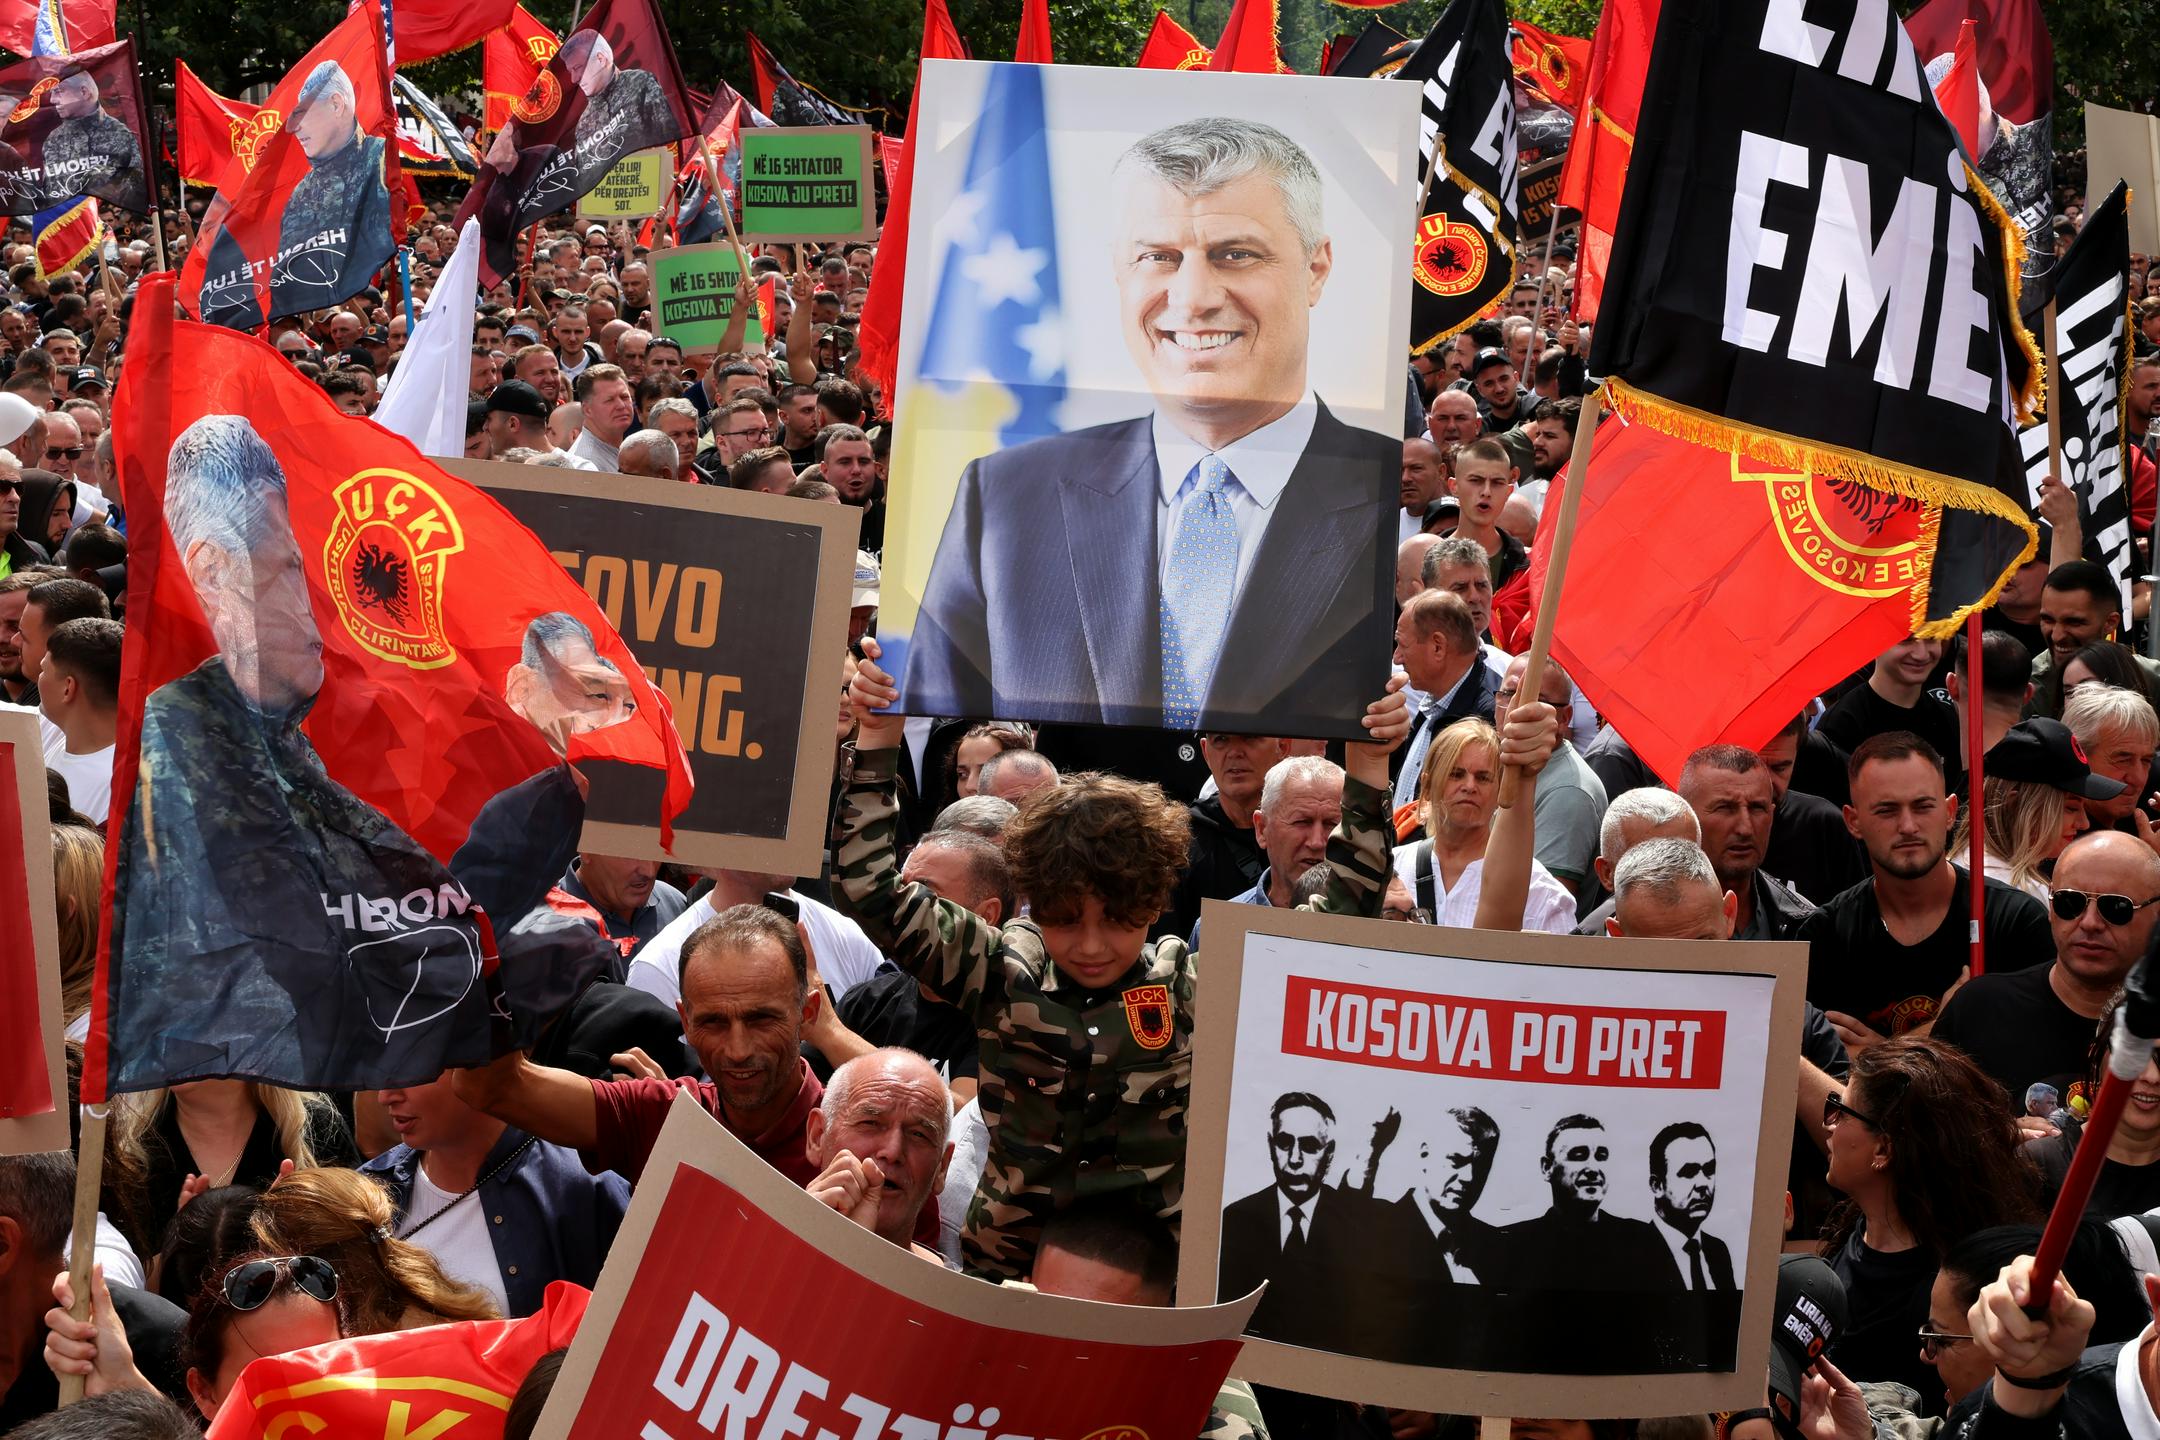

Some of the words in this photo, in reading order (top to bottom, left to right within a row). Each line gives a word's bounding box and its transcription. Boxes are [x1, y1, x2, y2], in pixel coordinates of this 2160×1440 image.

[754, 154, 767, 175] MË
[769, 157, 781, 175] 16
[784, 157, 842, 175] SHTATOR
[615, 200, 632, 211] SOT.
[748, 185, 789, 203] KOSOVA
[792, 185, 811, 204] JU
[813, 185, 853, 203] PRET!
[670, 272, 688, 294] MË
[690, 273, 706, 290] 16
[665, 298, 718, 321] KOSOVA
[352, 482, 448, 550] UÇK
[330, 527, 352, 614] USHTRIA
[1127, 989, 1165, 1003] UÇK
[1305, 988, 1493, 1069] KOSOVA
[1509, 1011, 1578, 1075] PO
[1587, 1017, 1702, 1079] PRET
[1796, 1296, 1826, 1329] LIRIA
[1783, 1313, 1814, 1347] EMËR
